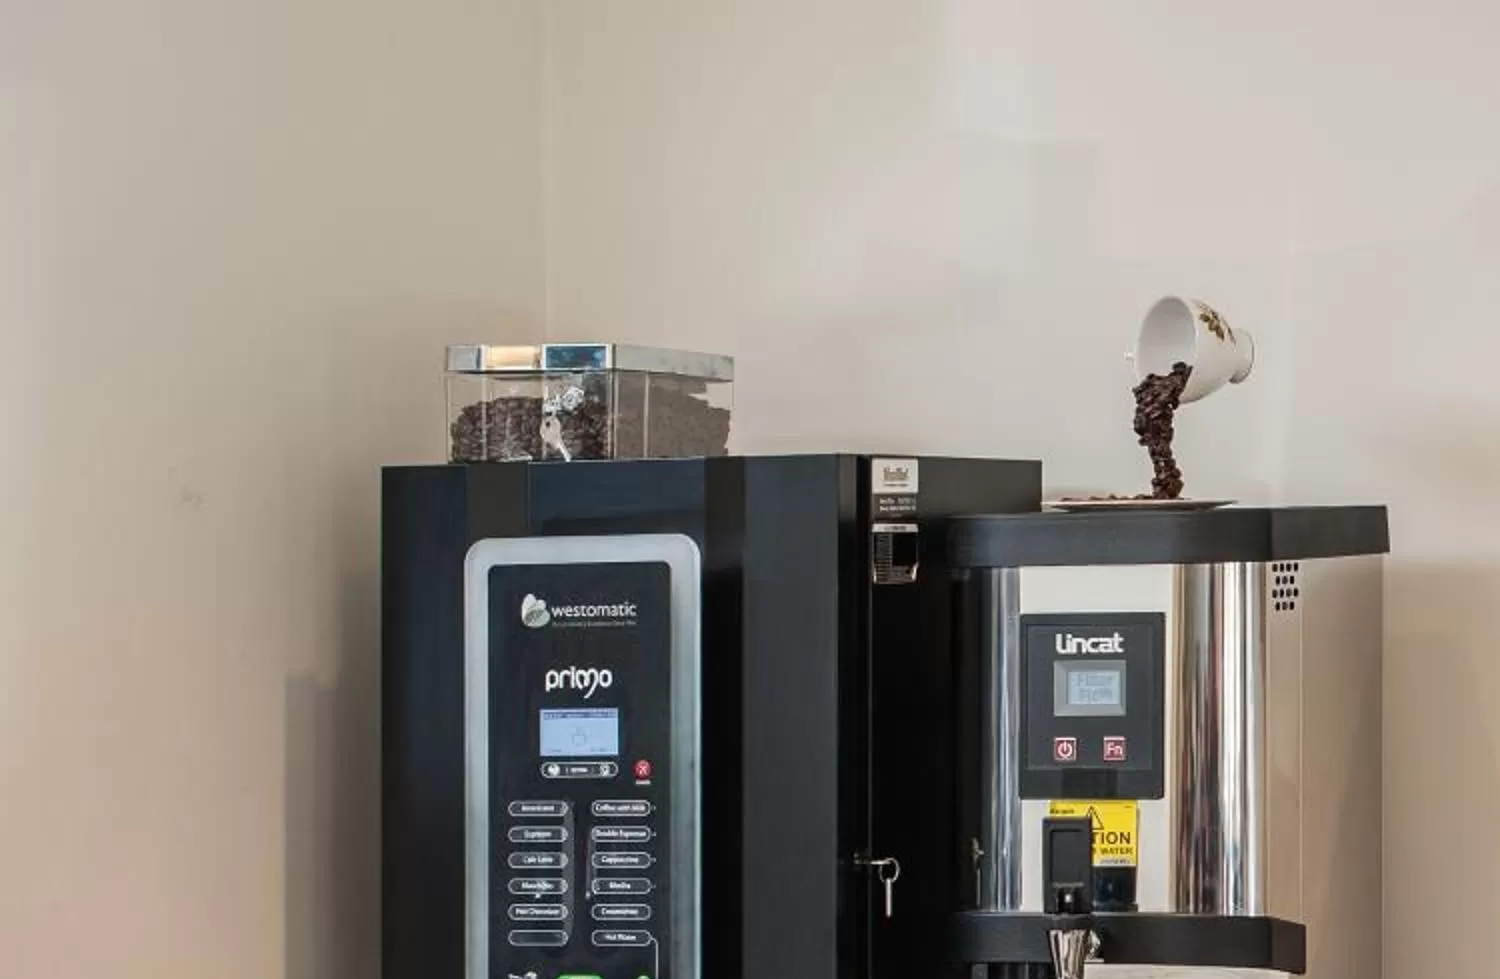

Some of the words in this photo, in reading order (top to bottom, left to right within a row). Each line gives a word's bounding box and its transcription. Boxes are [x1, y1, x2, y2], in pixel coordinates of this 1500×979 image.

[551, 599, 637, 618] westomatic
[1055, 632, 1125, 654] lincat
[545, 665, 613, 699] primo
[1106, 741, 1123, 756] Fn
[1091, 831, 1131, 845] TION
[1099, 846, 1133, 855] WATER
